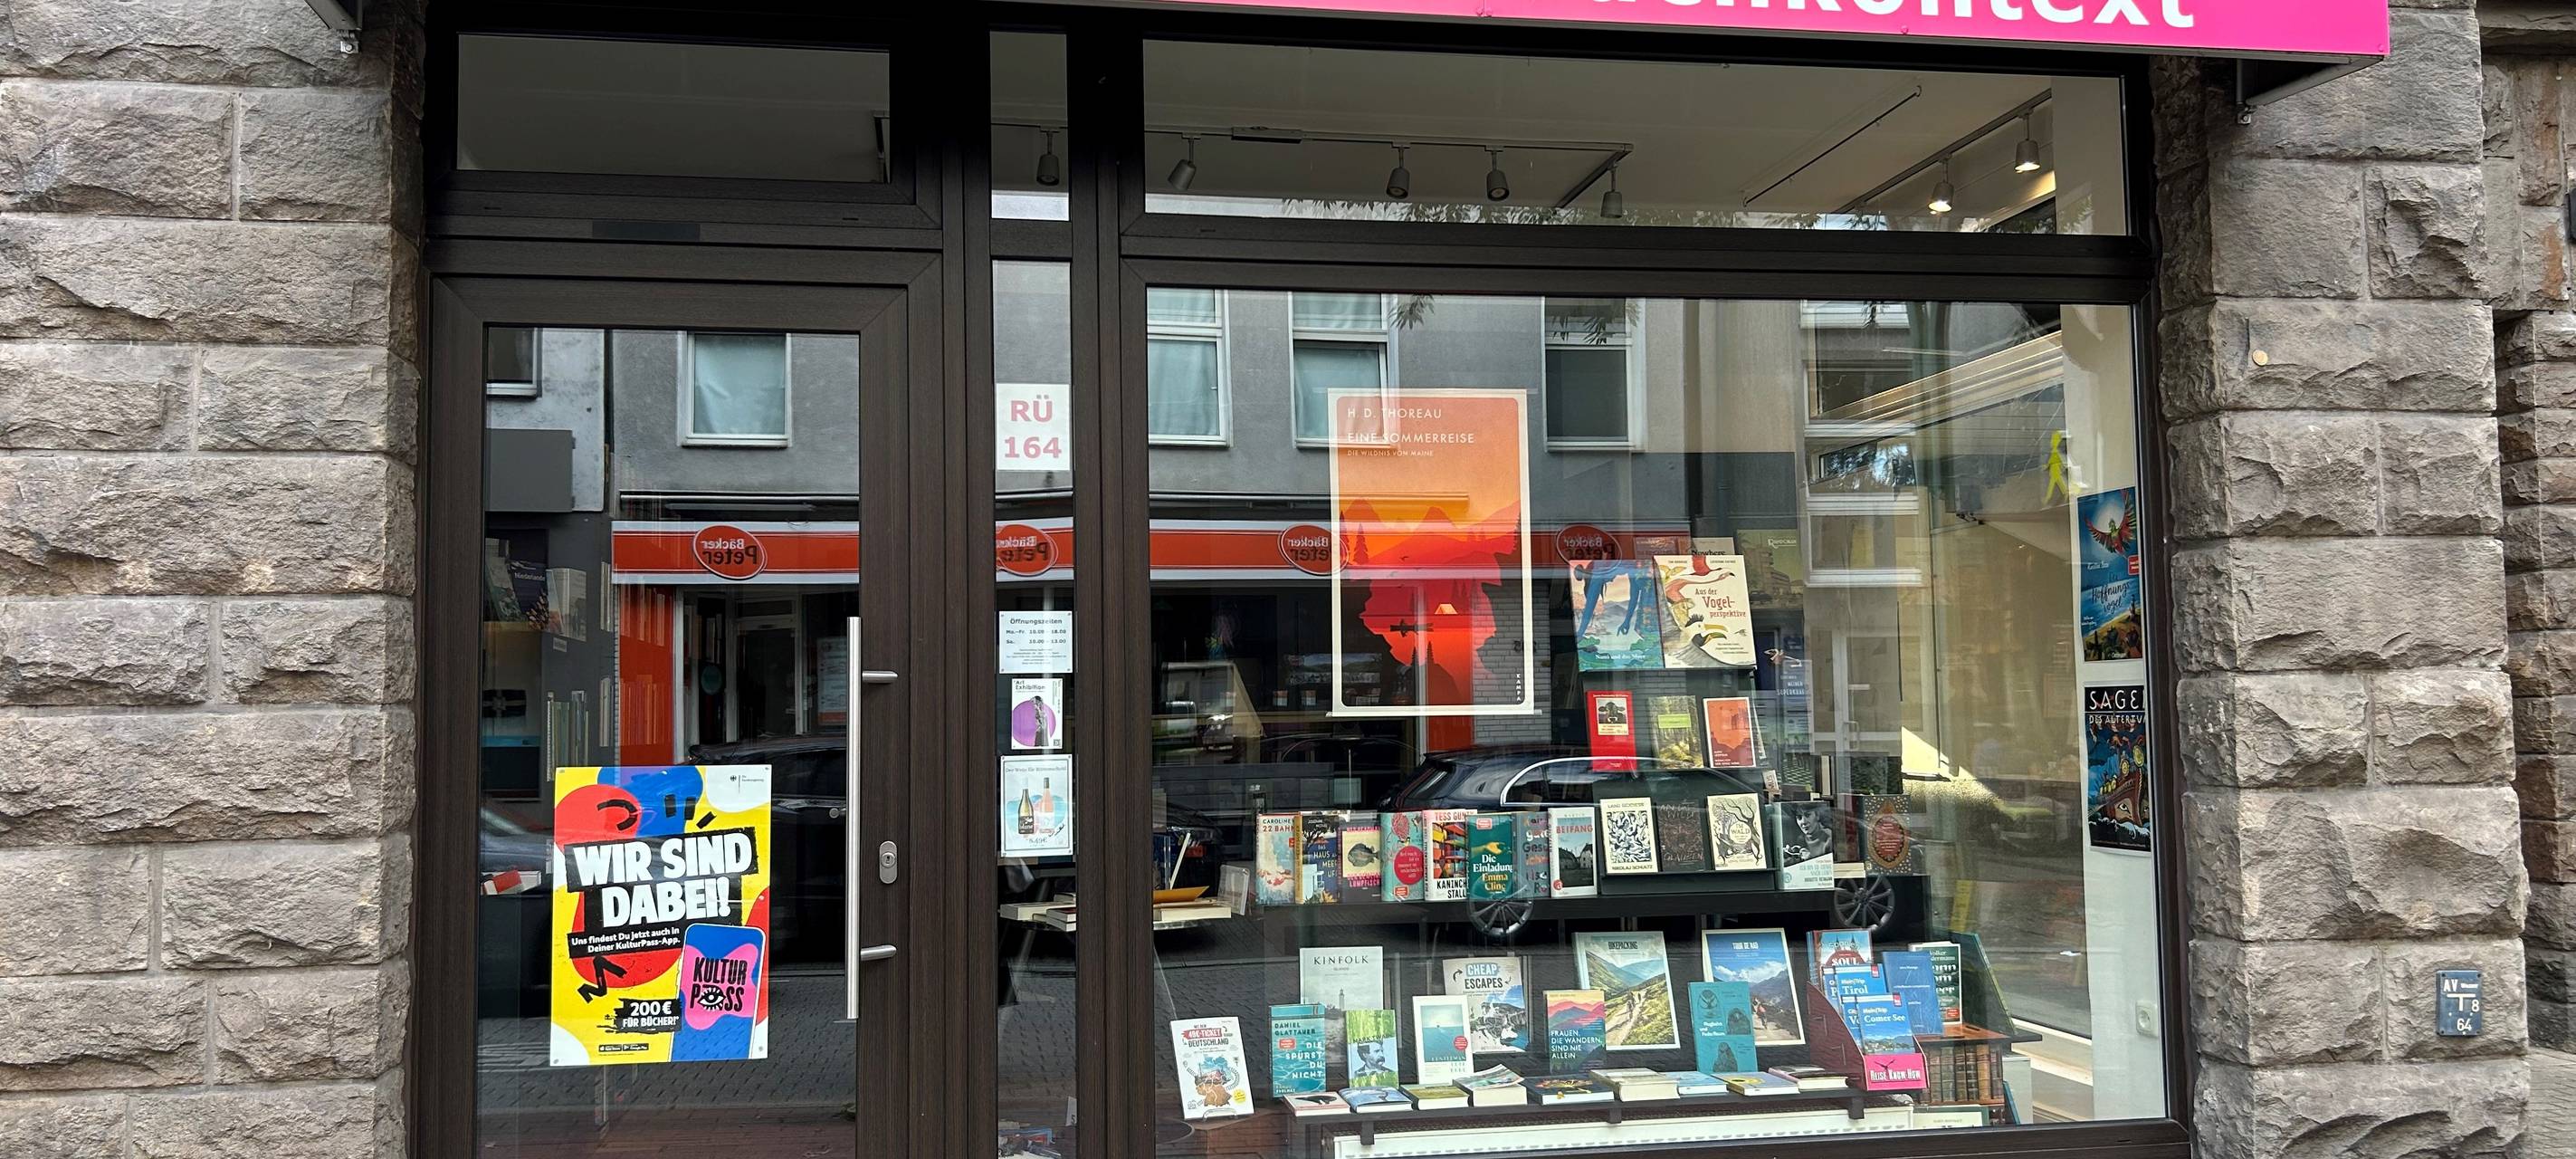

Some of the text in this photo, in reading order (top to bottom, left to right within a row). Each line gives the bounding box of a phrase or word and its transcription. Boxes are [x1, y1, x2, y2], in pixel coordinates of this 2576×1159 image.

[1010, 395, 1053, 422] RÜ
[1382, 407, 1442, 418] THOREAU
[1348, 433, 1475, 444] EINE SOMMERREISE
[1005, 436, 1062, 458] 164
[1694, 588, 1718, 596] Aus der
[1702, 596, 1736, 611] Vogel-
[1709, 610, 1747, 618] perspektive
[2089, 690, 2145, 710] SAGE
[1435, 811, 1451, 821] TESS
[1556, 825, 1593, 833] BEIFANG
[573, 833, 752, 886] WIR SIND
[1482, 854, 1497, 863] Die
[1483, 872, 1507, 882] Emma
[1437, 879, 1466, 889] KANINCH
[602, 876, 730, 927] DABEI!
[572, 927, 679, 946] Uns findest Du jetzt auch in
[588, 937, 680, 953] Deiner KulturPass-App.
[1608, 941, 1638, 949] BIKEPACKING
[1313, 955, 1369, 965] KINFOLK
[693, 957, 748, 985] KULTUR
[1467, 963, 1498, 976] CHEAP
[1465, 978, 1503, 989] ESCAPES
[2444, 979, 2458, 992] AV
[1841, 985, 1869, 995] Tirol
[630, 1001, 672, 1016] 200 €
[623, 1016, 639, 1028] FÜR
[1864, 1015, 1891, 1023] Comer
[1188, 1039, 1229, 1048] DEUTSCHLAND
[1285, 1050, 1323, 1060] SPÜRST
[1292, 1071, 1323, 1079] NICHT
